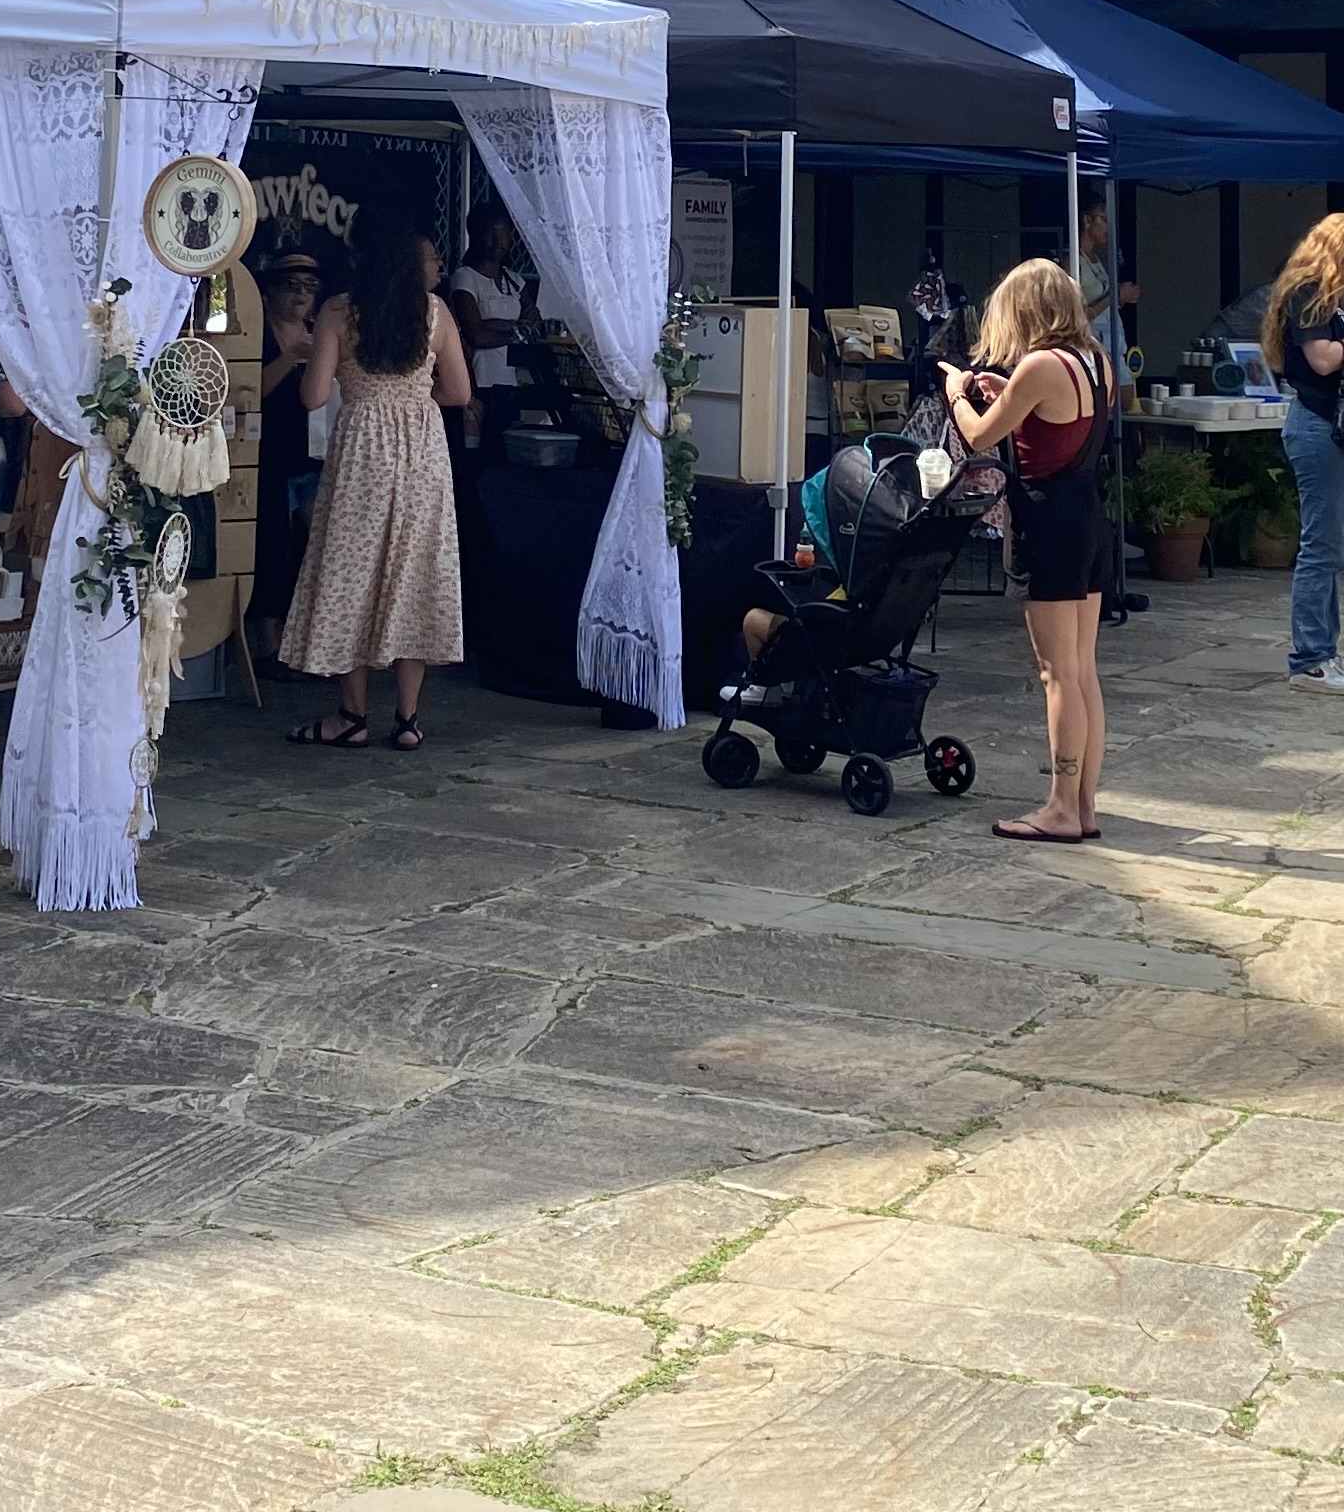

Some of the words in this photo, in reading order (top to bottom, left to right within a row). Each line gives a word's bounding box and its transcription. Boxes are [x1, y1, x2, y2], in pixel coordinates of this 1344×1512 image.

[176, 167, 227, 185] Gemini
[685, 199, 727, 216] FAMILY
[164, 240, 228, 263] Collaborative
